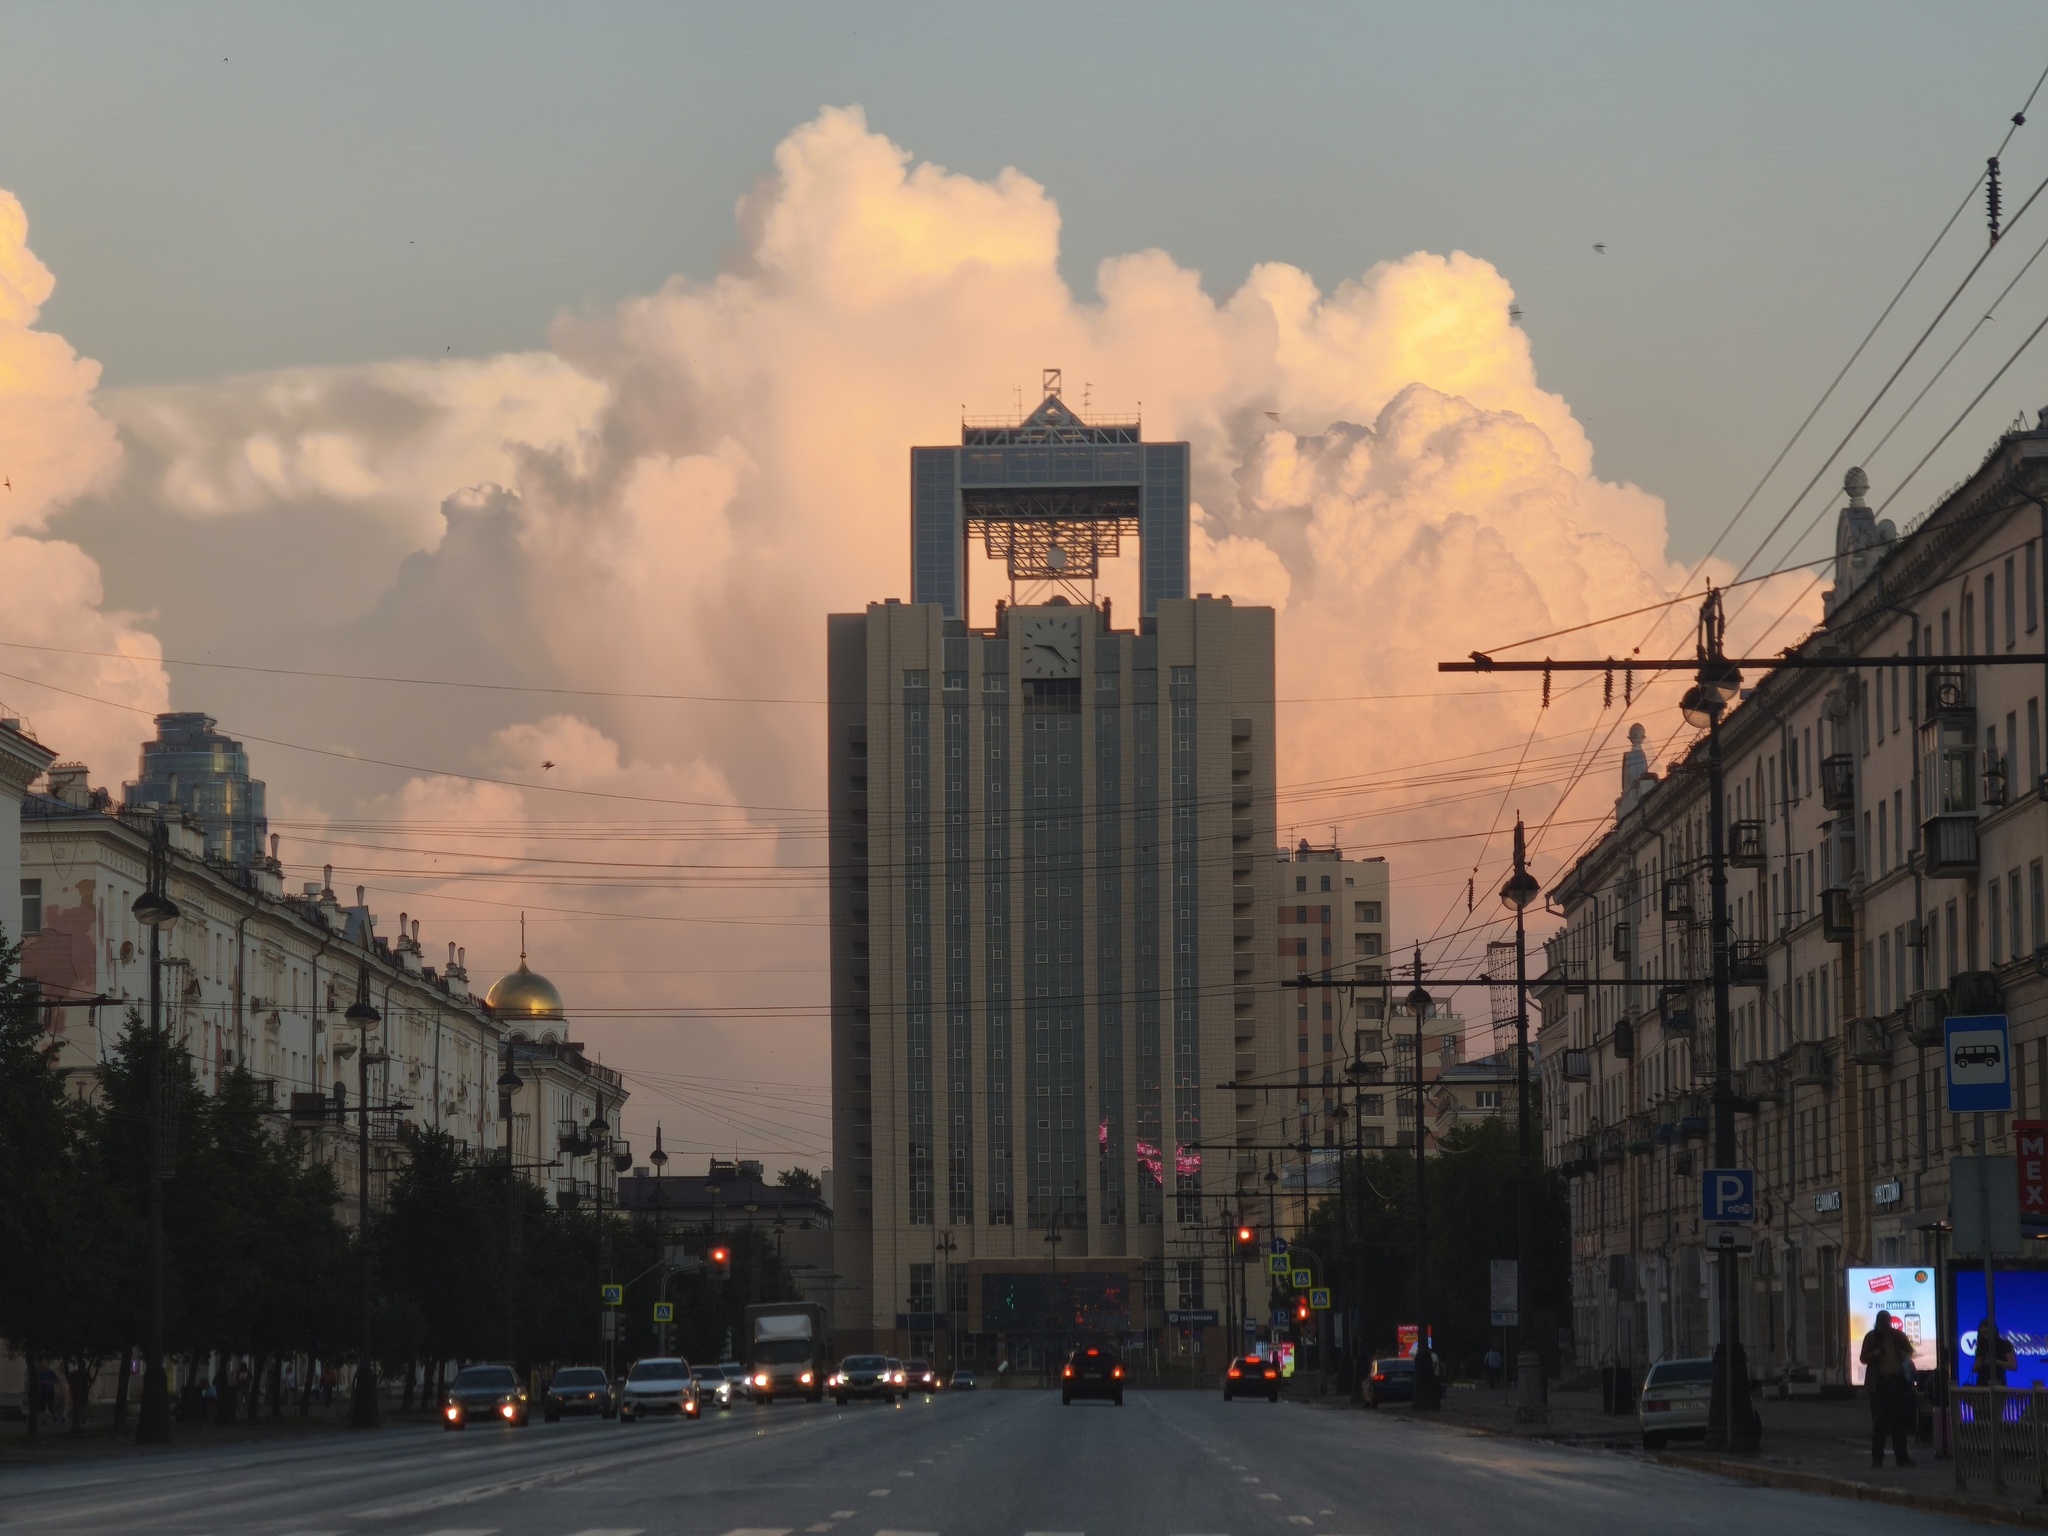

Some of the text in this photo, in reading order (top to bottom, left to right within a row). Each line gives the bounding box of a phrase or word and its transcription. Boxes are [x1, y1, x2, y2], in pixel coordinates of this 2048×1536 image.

[1716, 1175, 1745, 1216] P
[2021, 1136, 2045, 1214] МЕХ
[1868, 1301, 1873, 1309] 2
[1887, 1302, 1907, 1310] цене
